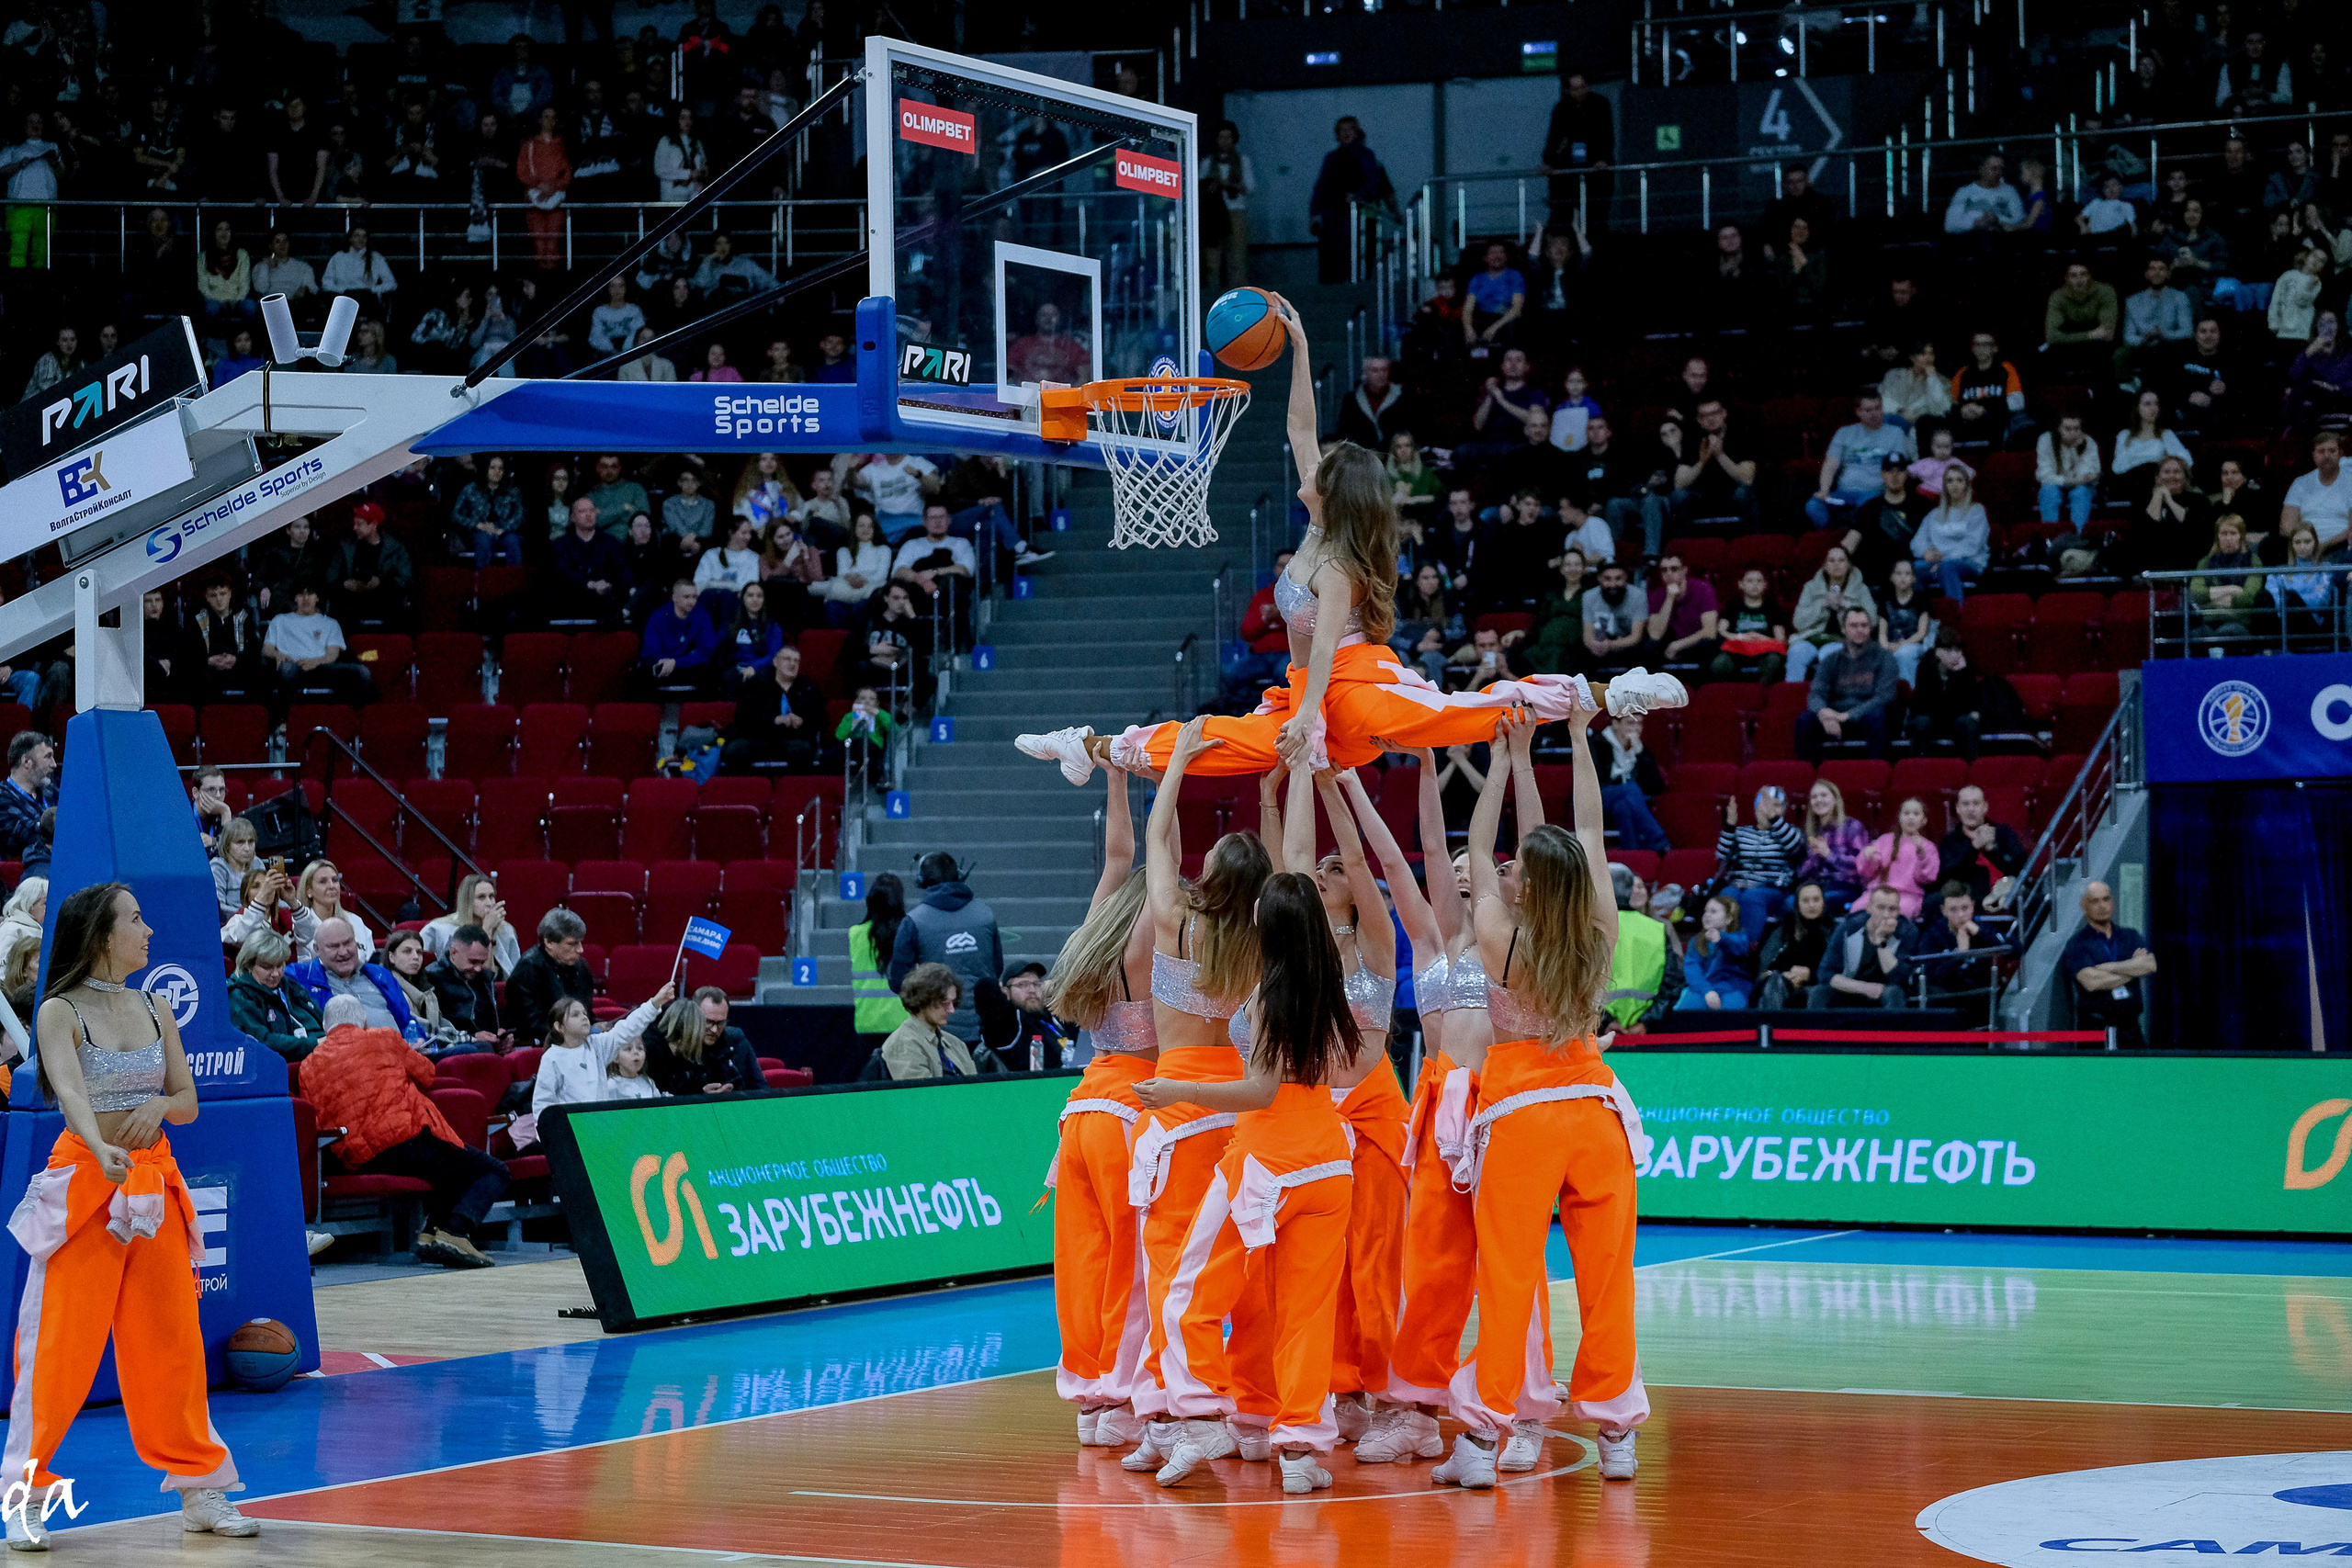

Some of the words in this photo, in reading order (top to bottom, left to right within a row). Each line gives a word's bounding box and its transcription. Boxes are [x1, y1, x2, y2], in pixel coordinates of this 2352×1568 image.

[902, 111, 972, 141] OLIMPBET
[1759, 88, 1792, 141] 4
[1118, 160, 1179, 188] OLIMPBET
[902, 344, 971, 383] PARI
[41, 354, 150, 446] PARI
[714, 394, 820, 414] Schelde
[715, 414, 820, 439] Sports
[181, 491, 258, 537] Schelde
[259, 457, 322, 496] Sports
[979, 652, 989, 669] 6
[938, 724, 947, 740] 5
[893, 797, 902, 815] 4
[848, 880, 857, 897] 3
[799, 964, 809, 983] 2
[1781, 1107, 1890, 1126] ОБЩЕСТВО
[708, 1160, 810, 1188] АКЦИОНЕРНОЕ
[813, 1153, 888, 1177] ОБЩЕСТВО
[718, 1177, 1002, 1257] ЗАРУБЕЖНЕФТЬ
